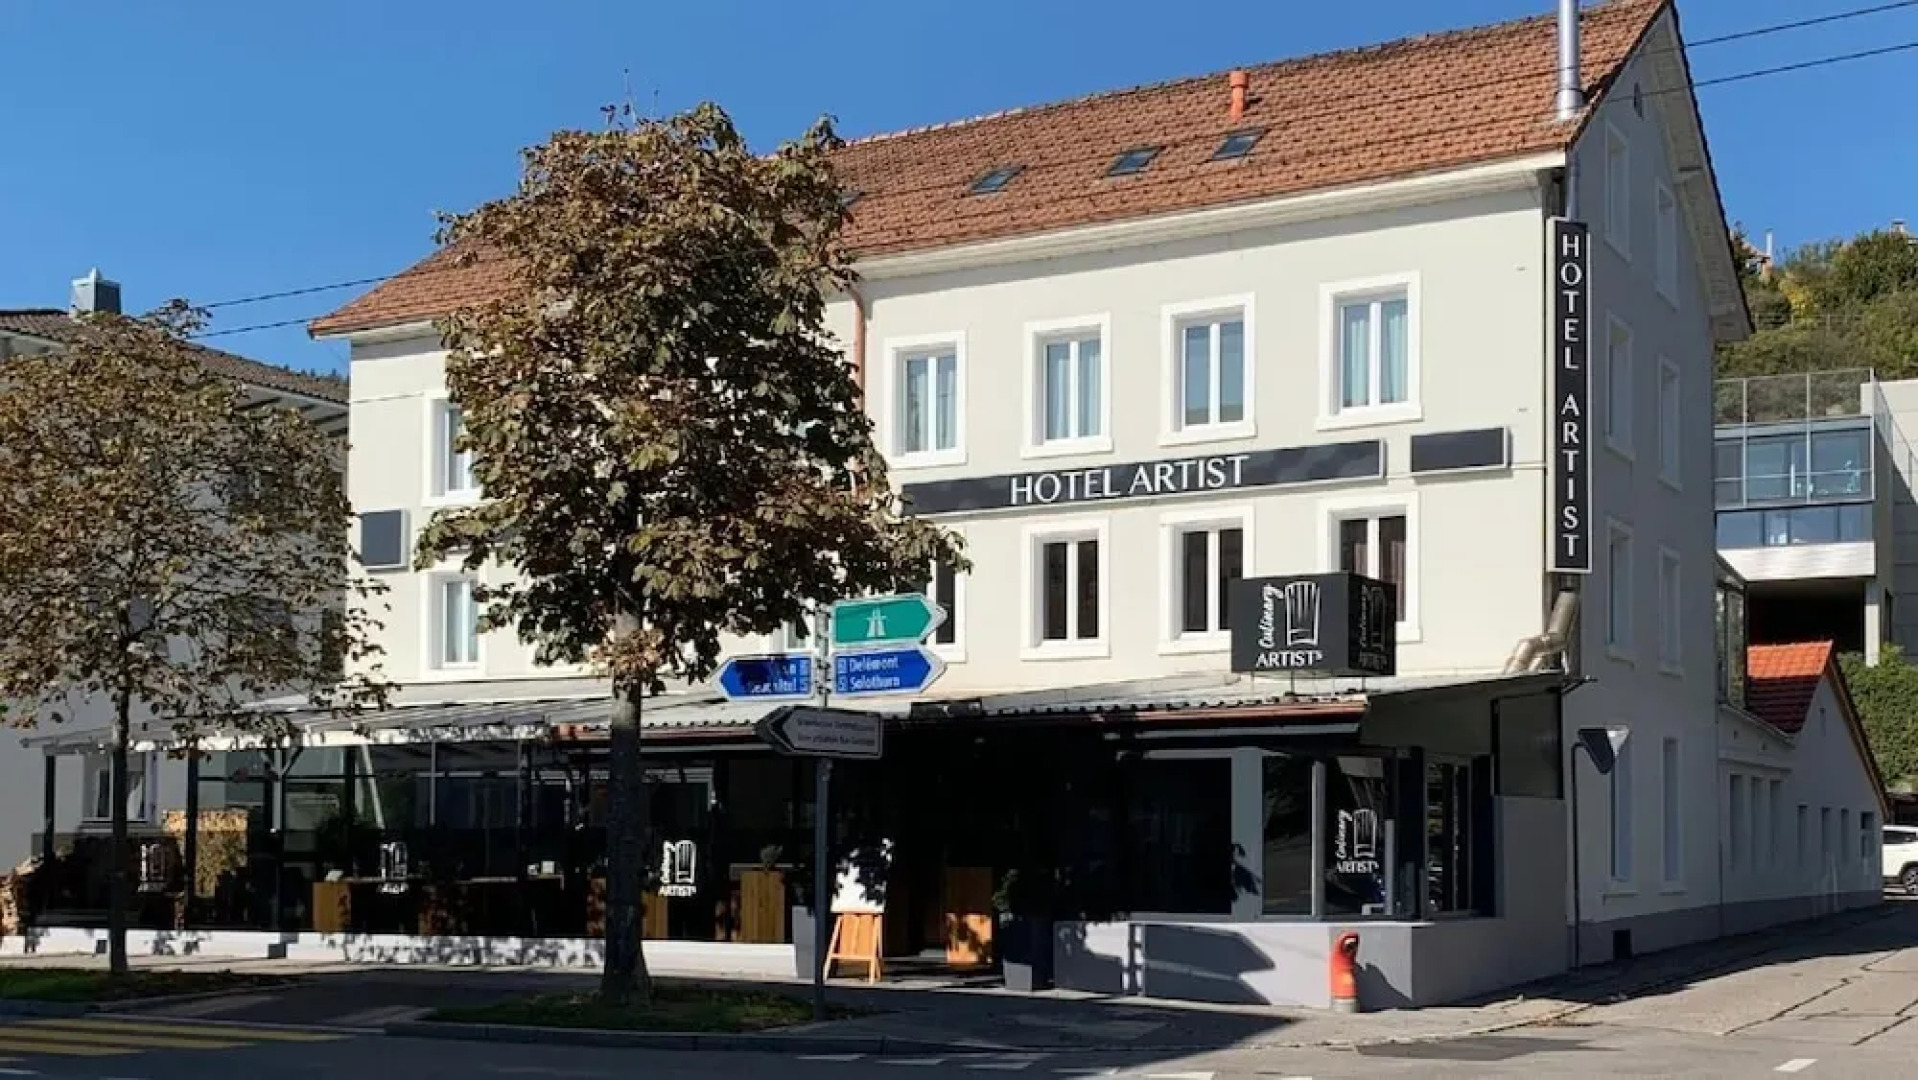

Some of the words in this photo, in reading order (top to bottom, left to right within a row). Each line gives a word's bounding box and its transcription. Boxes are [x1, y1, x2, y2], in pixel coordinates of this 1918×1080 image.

[1561, 233, 1583, 370] HOTEL
[1010, 467, 1121, 505] HOTEL
[1129, 454, 1251, 495] ARTIST
[1560, 392, 1581, 557] ARTIST
